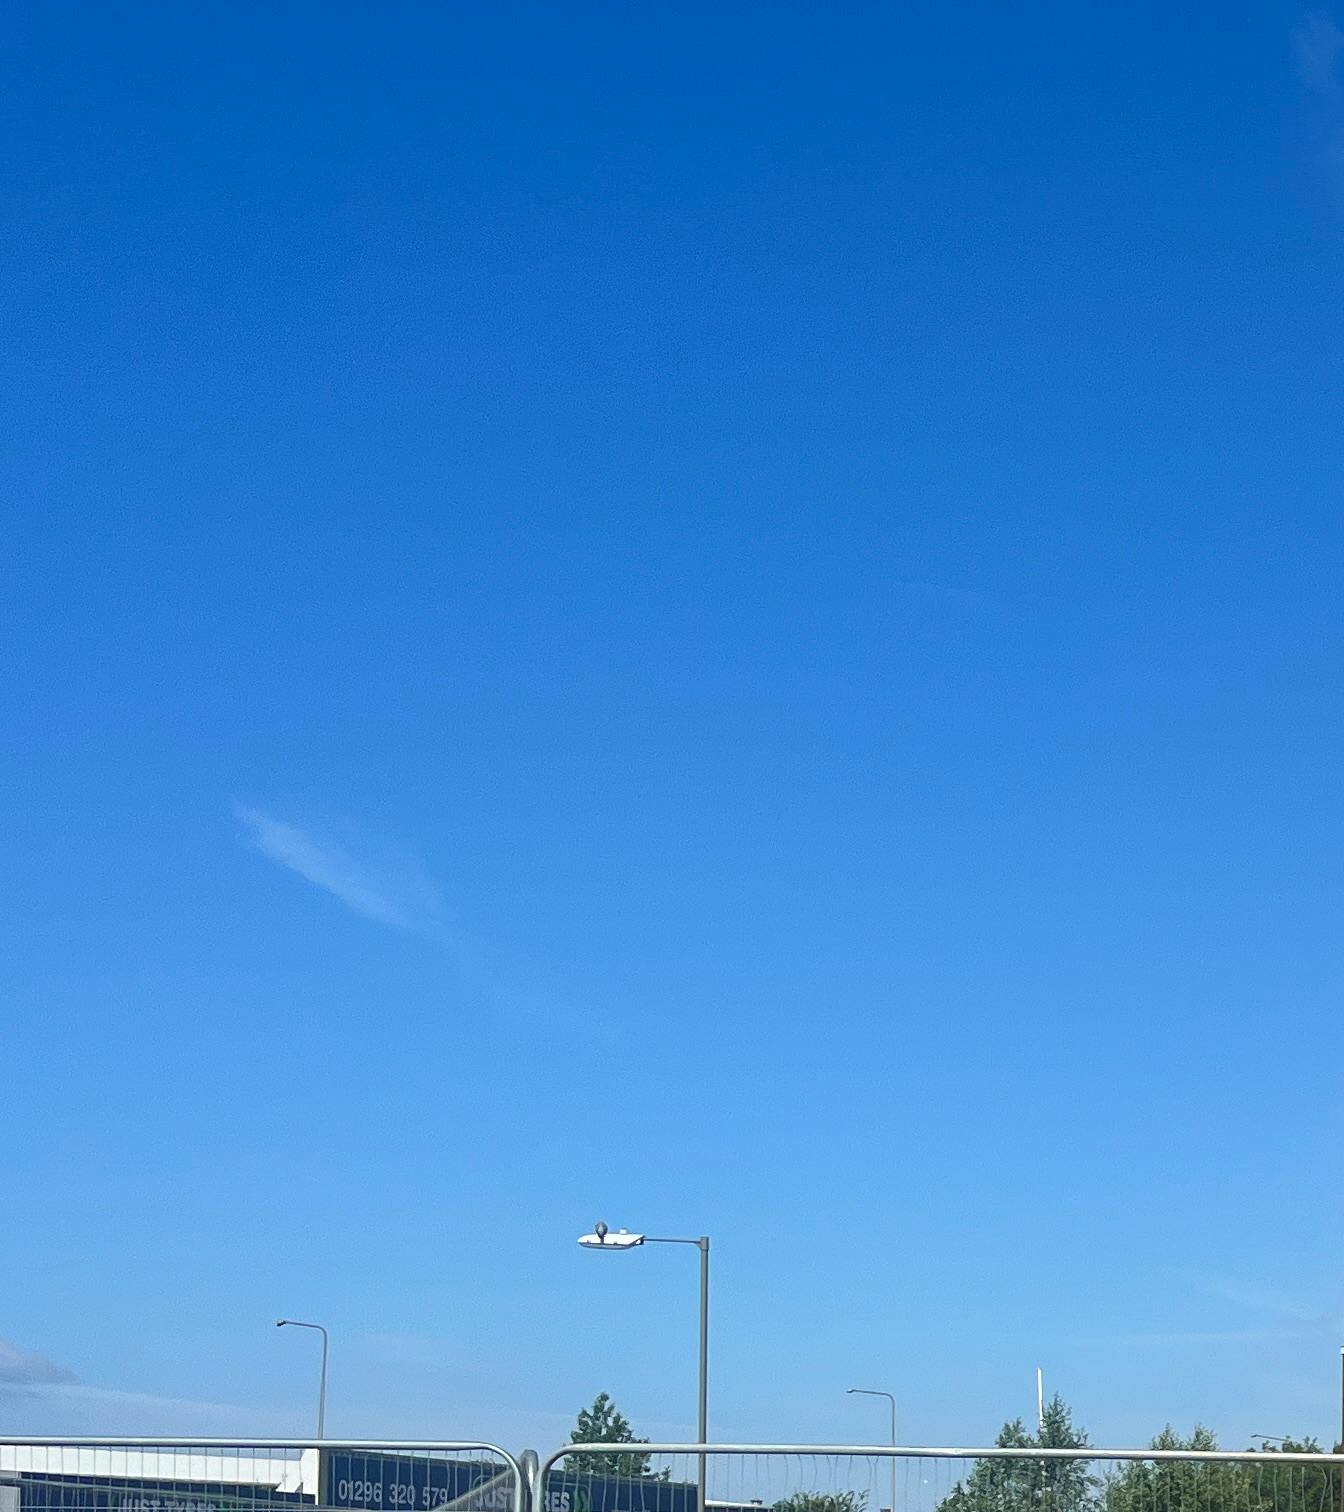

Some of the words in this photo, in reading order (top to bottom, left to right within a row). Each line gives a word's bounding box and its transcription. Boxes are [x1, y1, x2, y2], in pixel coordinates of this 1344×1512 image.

[338, 1479, 382, 1503] 01296
[388, 1484, 415, 1503] 320
[422, 1486, 448, 1506] 579
